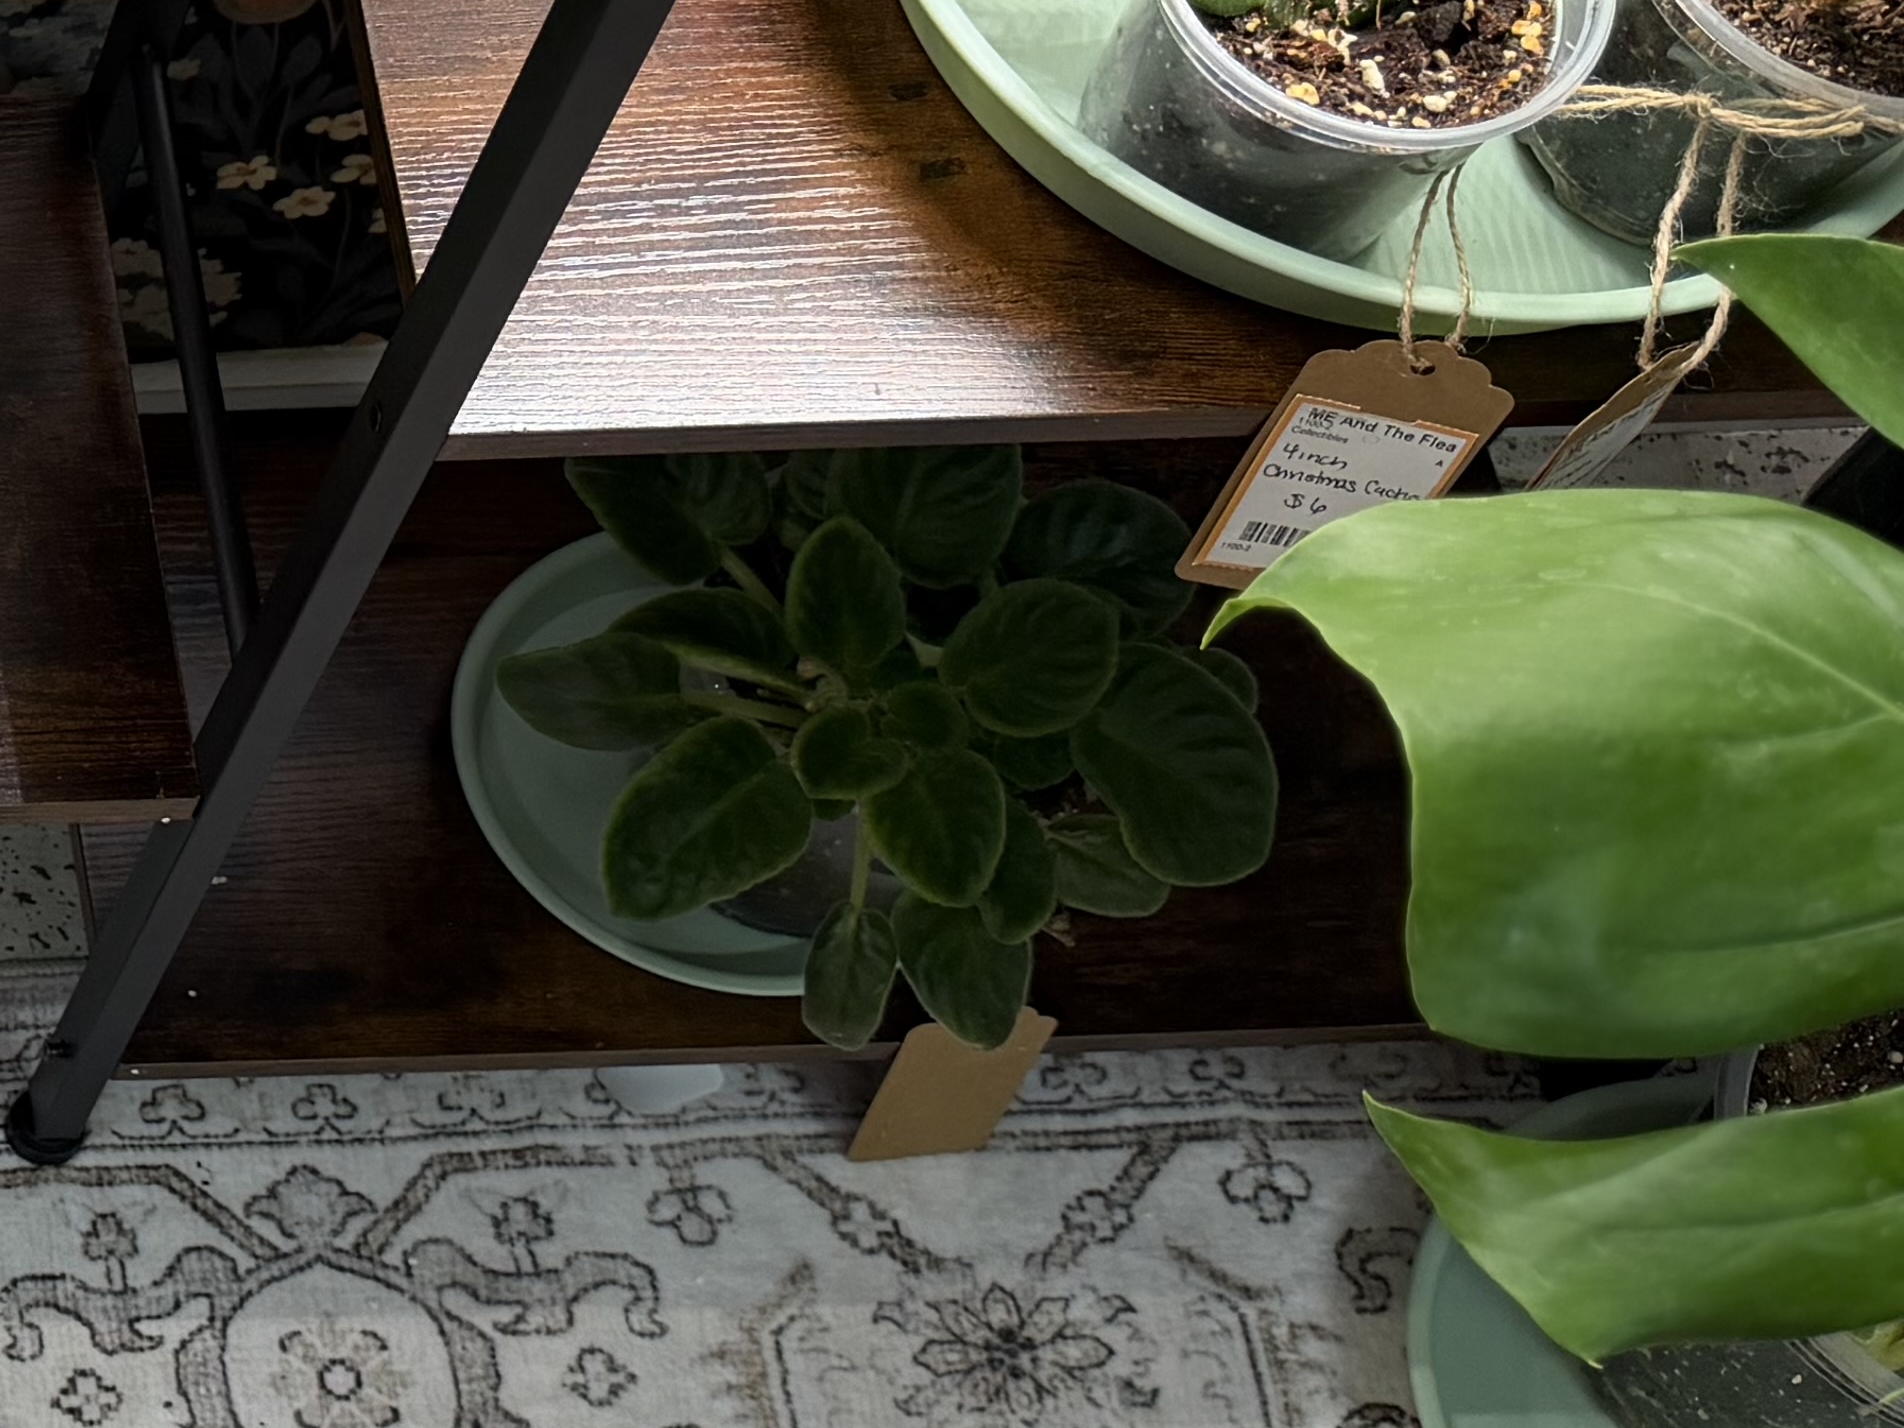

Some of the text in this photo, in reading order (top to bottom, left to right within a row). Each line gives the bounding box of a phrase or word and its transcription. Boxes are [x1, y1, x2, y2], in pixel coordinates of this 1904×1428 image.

[1291, 425, 1349, 444] Collectibles
[1307, 407, 1457, 453] ME And The Flea
[1263, 463, 1357, 493] Christmas
